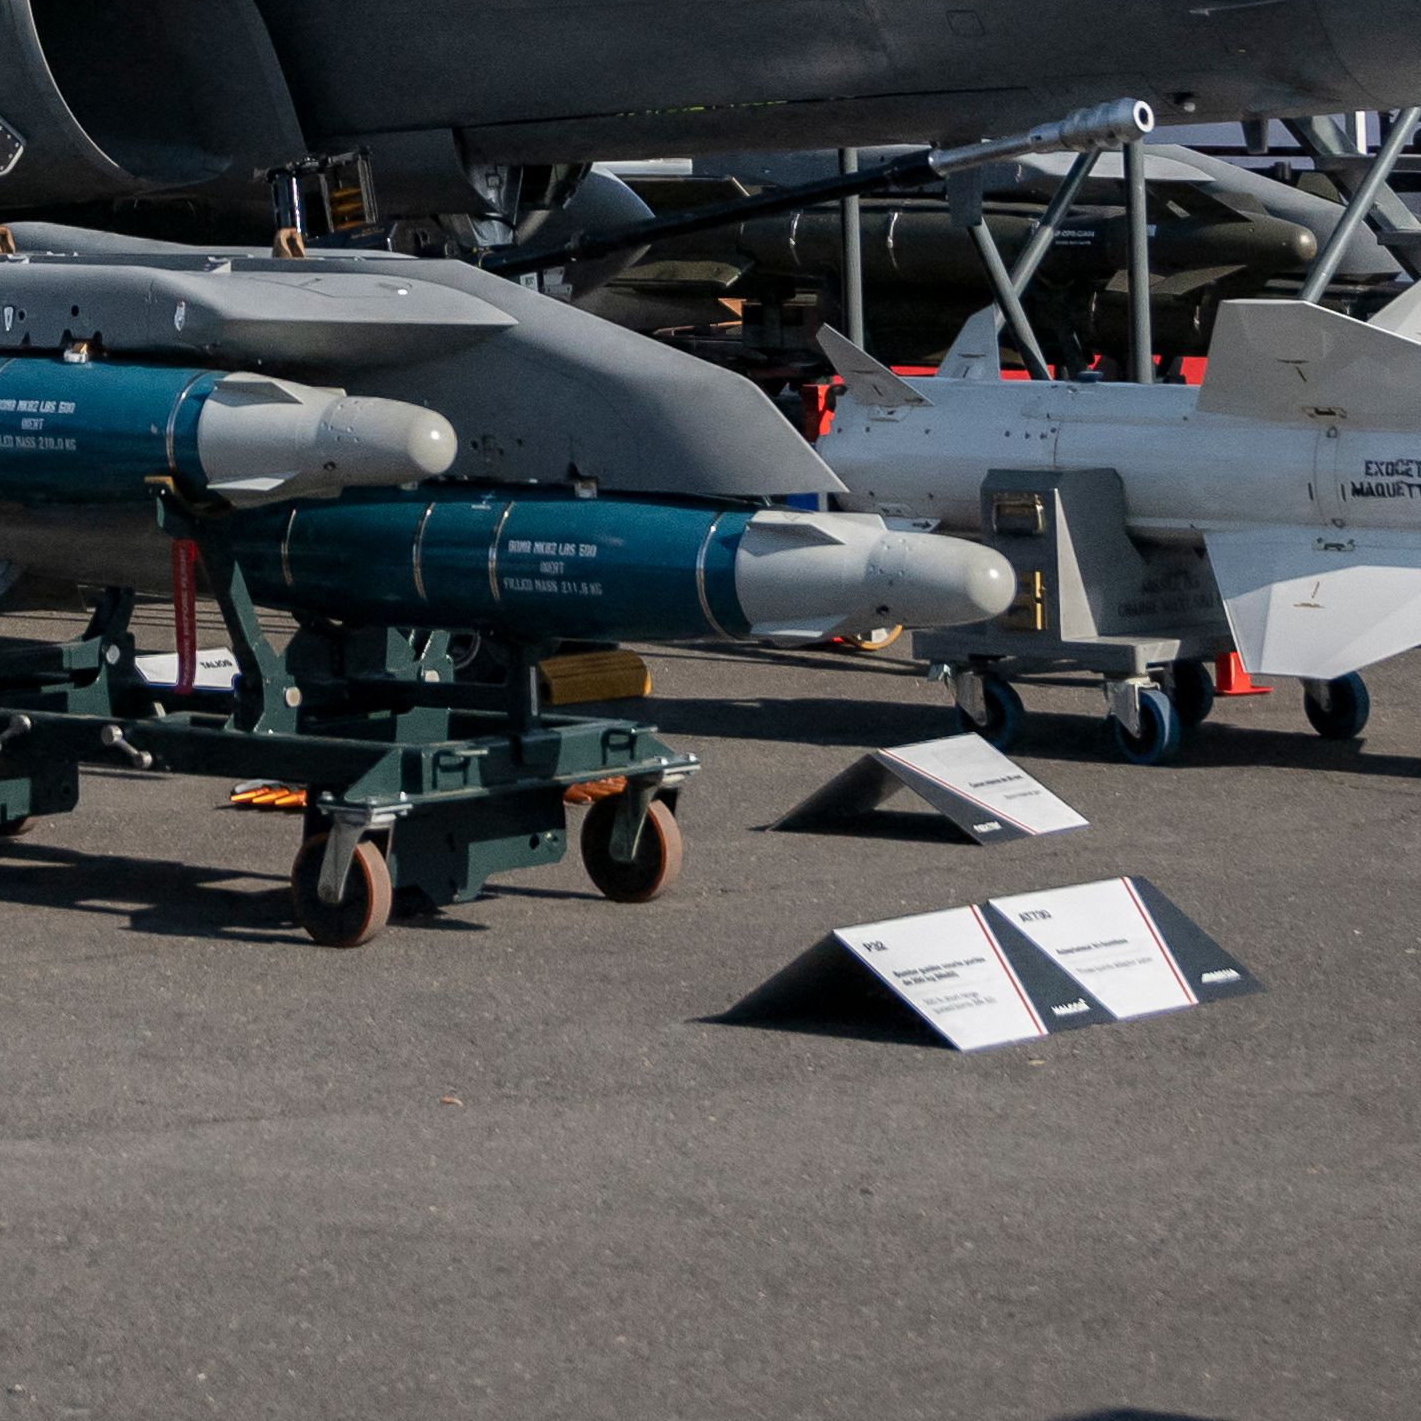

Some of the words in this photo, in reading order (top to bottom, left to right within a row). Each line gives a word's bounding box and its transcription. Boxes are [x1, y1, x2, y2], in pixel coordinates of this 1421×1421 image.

[39, 401, 56, 413] LBS
[15, 435, 36, 449] MASS
[558, 543, 576, 556] LBS
[534, 579, 558, 592] MASS
